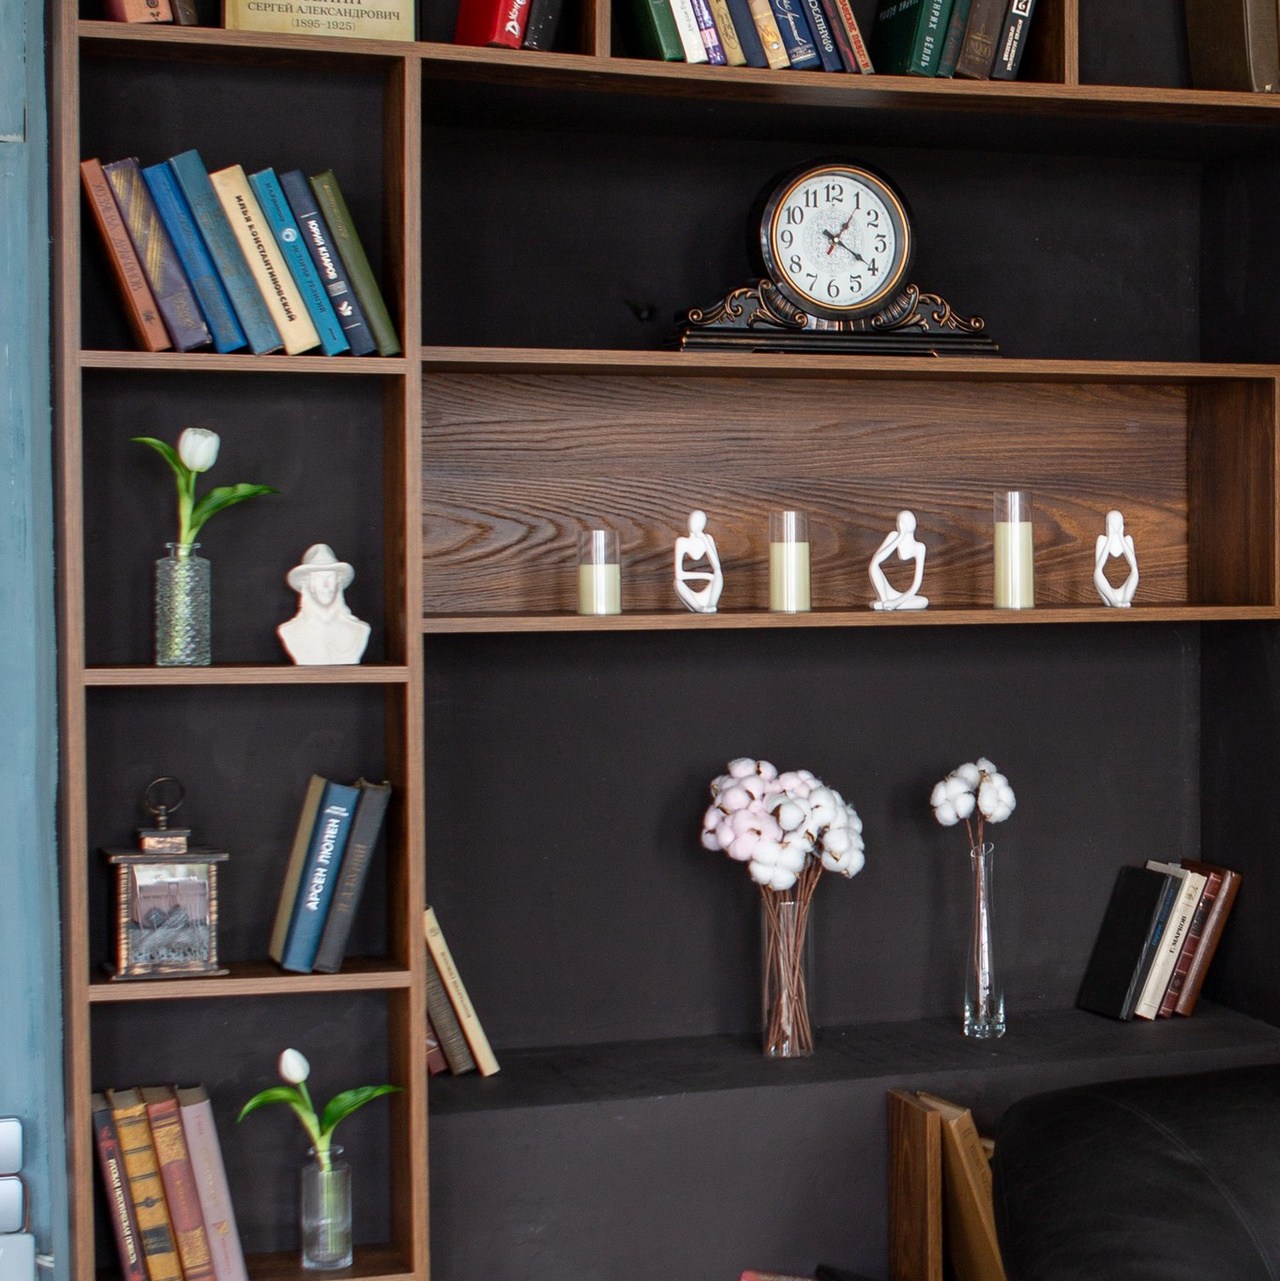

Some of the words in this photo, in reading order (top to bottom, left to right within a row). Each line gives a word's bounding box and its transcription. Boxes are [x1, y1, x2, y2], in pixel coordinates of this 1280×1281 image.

[247, 0, 292, 12] СЕРГЕЙ
[296, 4, 400, 21] АЛЕКСАНДРОВИЧ
[503, 2, 523, 37] Джон
[803, 188, 819, 208] 11
[824, 183, 844, 203] 12
[853, 192, 861, 210] 1
[785, 206, 804, 225] 10
[867, 210, 879, 228] 2
[91, 180, 120, 231] ХОЗЯЕВА
[111, 233, 144, 292] ДРАКОНОВ
[307, 218, 324, 245] ЮРИЙ
[781, 230, 794, 249] 9
[874, 234, 887, 254] 3
[234, 194, 252, 222] ИЛЬЯ
[246, 222, 297, 322] КОНСТАНТИНОВСКИЙ
[291, 243, 311, 278] ИСТОРИЯ
[315, 244, 338, 280] КЛАРОВ
[789, 255, 802, 274] 8
[867, 259, 879, 276] 4
[806, 273, 819, 292] 7
[827, 278, 840, 298] 6
[850, 275, 862, 293] 5
[304, 865, 328, 912] АРСЕН
[317, 817, 341, 865] ЛЮПЕН
[1171, 915, 1186, 946] МАРКОВ
